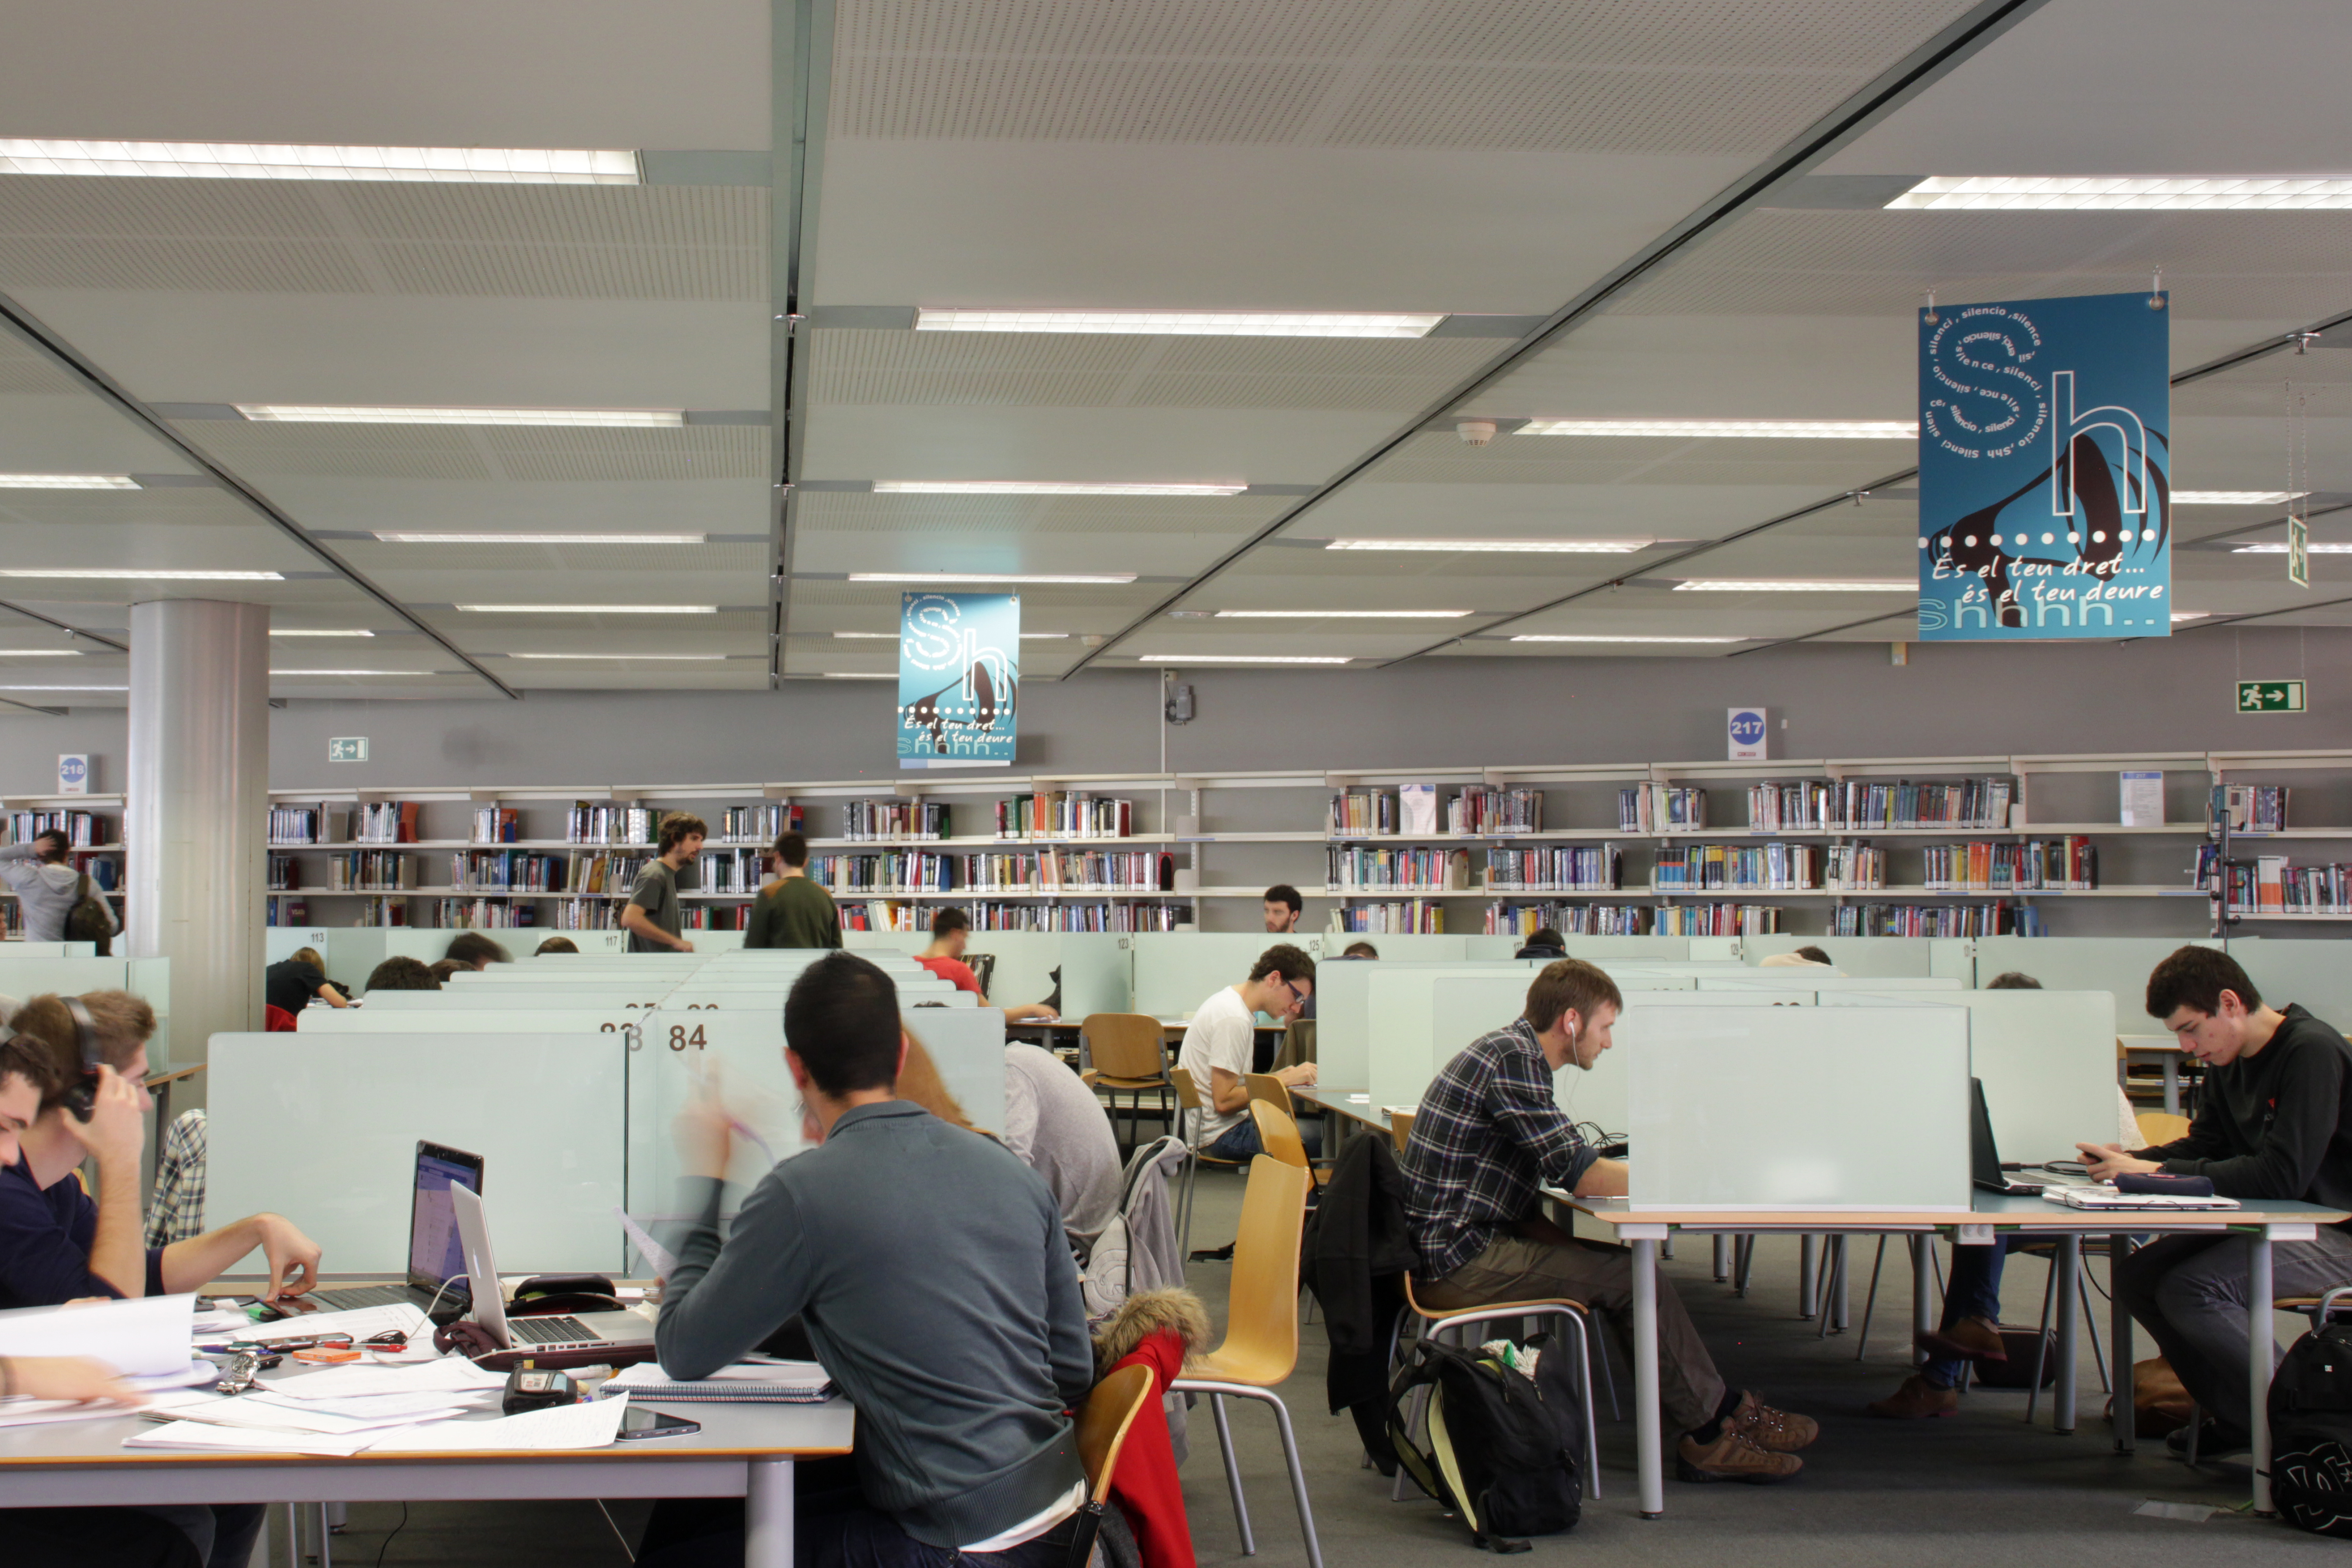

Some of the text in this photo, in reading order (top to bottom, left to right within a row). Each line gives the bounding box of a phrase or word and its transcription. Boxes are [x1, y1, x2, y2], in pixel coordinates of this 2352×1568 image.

[1929, 318, 1953, 355] silenci
[1961, 306, 2006, 318] silencio
[1932, 553, 1966, 579] És
[1977, 555, 1999, 578] el
[2009, 555, 2052, 577] teu
[1962, 580, 2163, 603] és el teu deure
[904, 715, 921, 729] És
[926, 717, 938, 729] el
[941, 717, 962, 730] teu
[1731, 721, 1763, 734] 217
[918, 730, 1013, 743] és el teu deure
[61, 764, 84, 775] 218
[311, 933, 324, 942] 113
[606, 936, 617, 946] 117
[1118, 938, 1129, 949] 123
[1309, 940, 1319, 951] 125
[669, 1024, 707, 1051] 84
